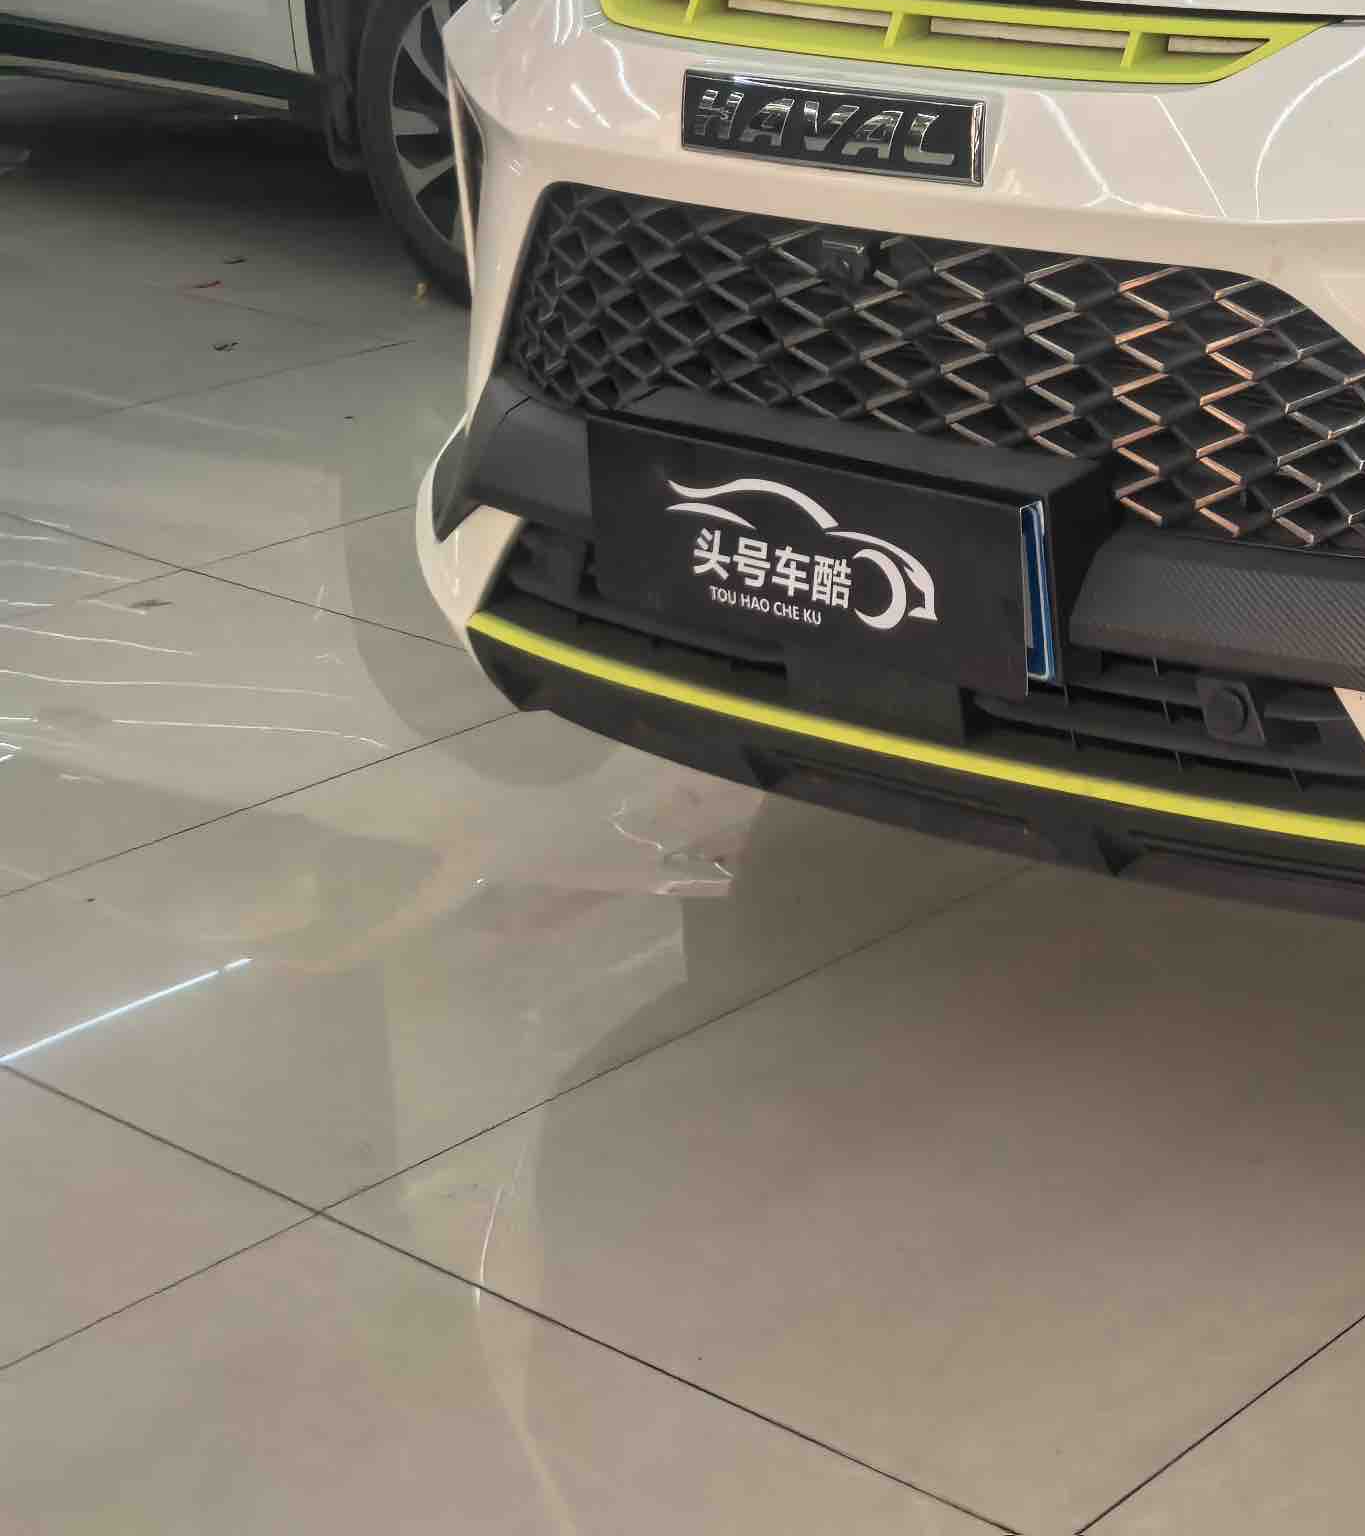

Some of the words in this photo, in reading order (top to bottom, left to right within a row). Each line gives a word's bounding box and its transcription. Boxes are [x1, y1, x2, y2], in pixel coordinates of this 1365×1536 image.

[691, 89, 956, 166] HAVAL
[692, 527, 852, 609] 头号车酷
[709, 584, 737, 606] TOU
[740, 593, 771, 613] HAO
[773, 601, 800, 621] CHE
[803, 610, 822, 626] KU
